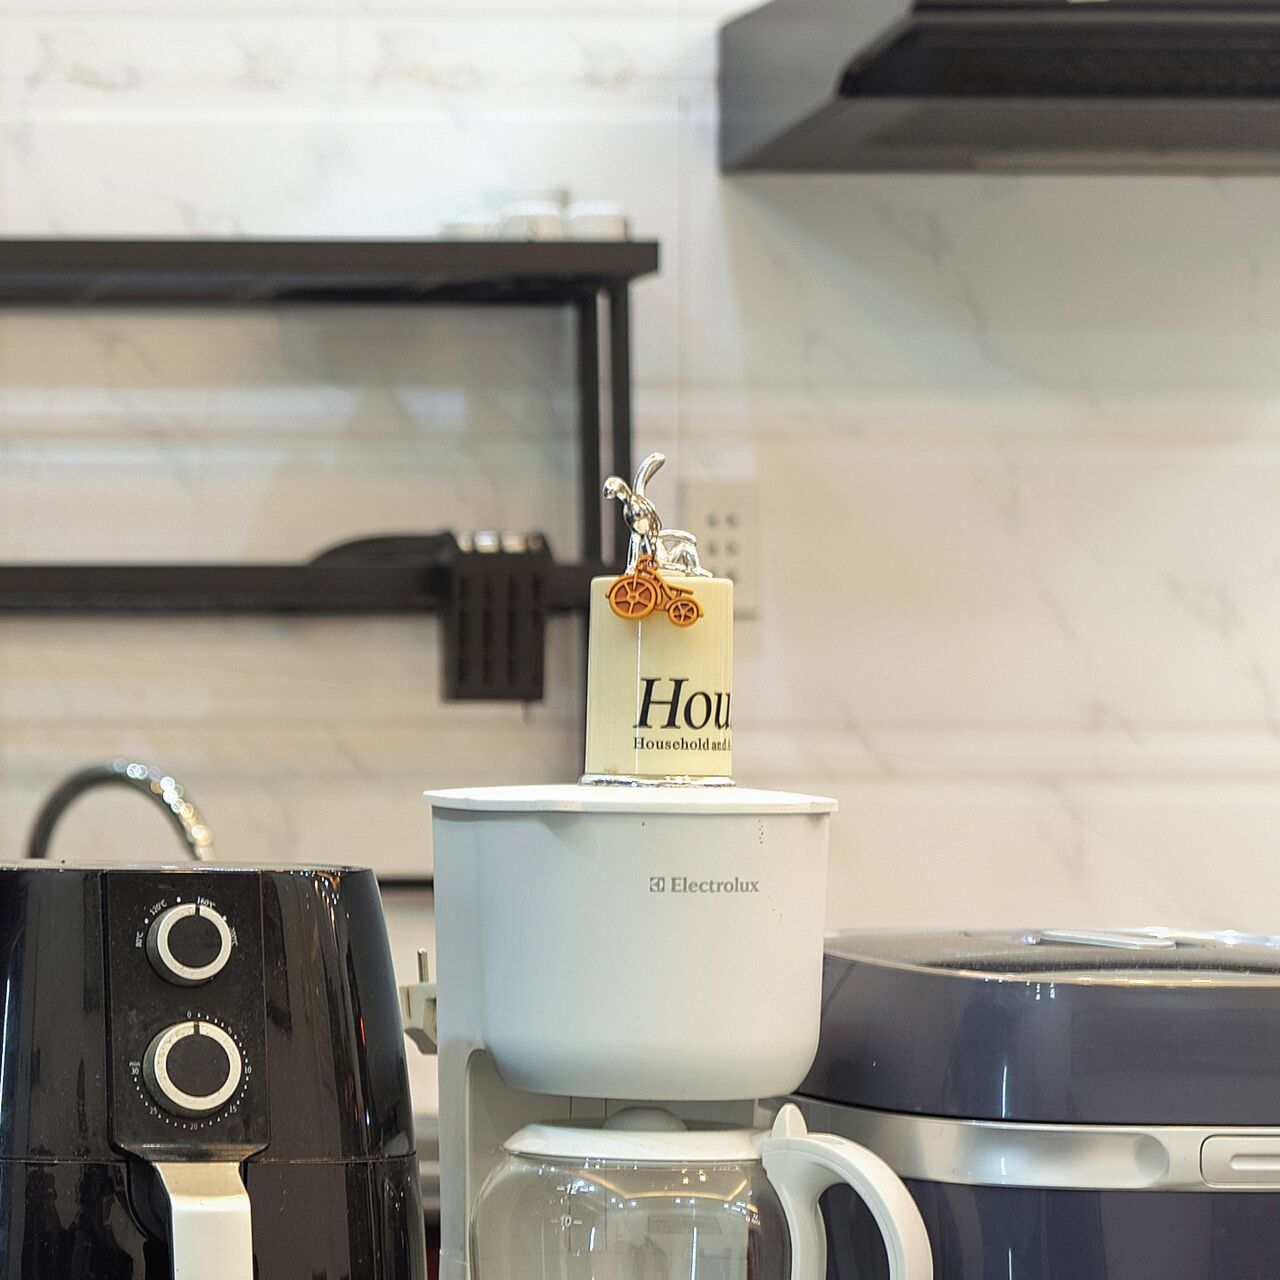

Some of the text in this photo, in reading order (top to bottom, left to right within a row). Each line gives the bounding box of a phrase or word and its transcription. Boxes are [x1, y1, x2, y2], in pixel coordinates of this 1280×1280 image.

[633, 736, 710, 752] Household
[670, 876, 760, 893] Electrolux
[131, 1066, 140, 1076] 30
[244, 1065, 252, 1075] 10
[149, 1106, 158, 1116] 25
[229, 1104, 238, 1114] 15
[190, 1122, 199, 1132] 20
[566, 1183, 577, 1195] 12
